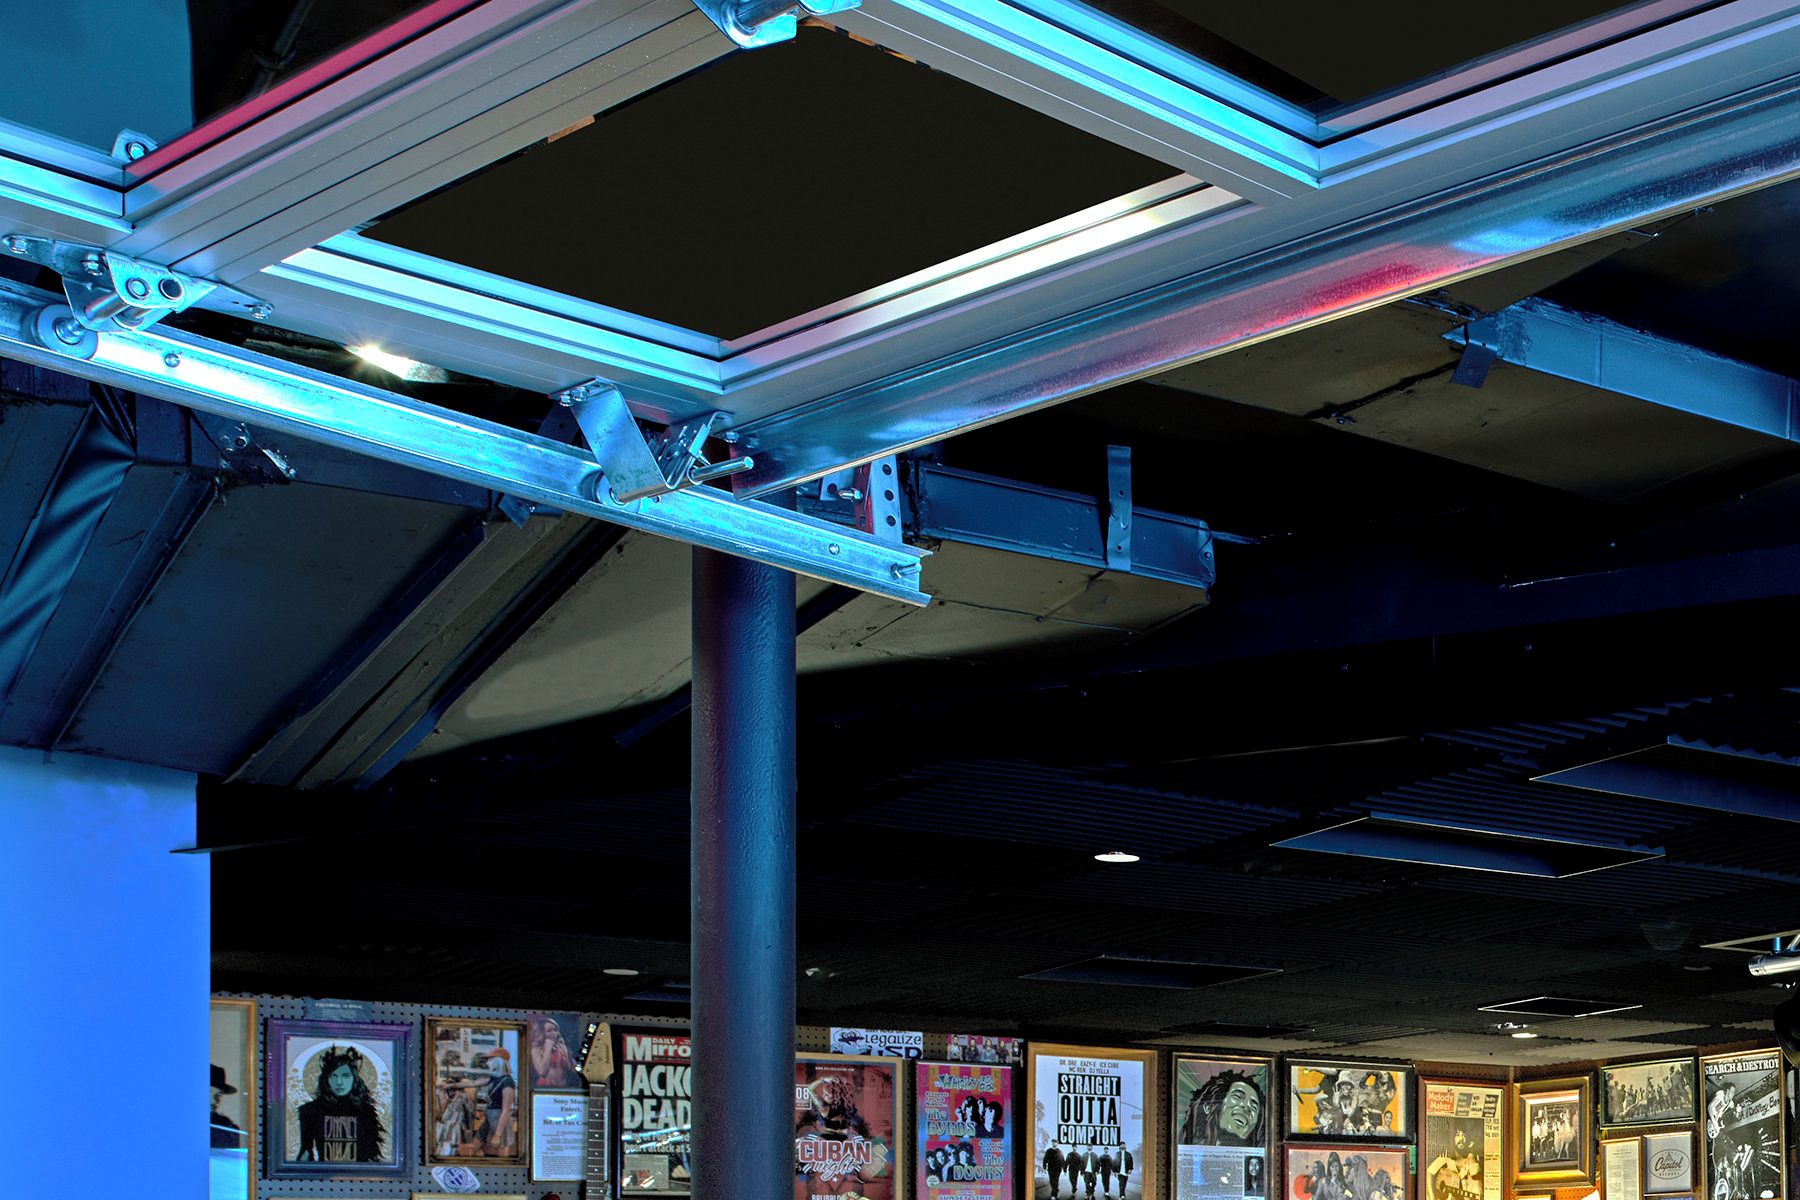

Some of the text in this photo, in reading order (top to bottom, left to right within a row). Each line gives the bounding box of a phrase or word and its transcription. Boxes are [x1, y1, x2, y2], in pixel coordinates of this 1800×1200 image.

[626, 1036, 691, 1061] Mirro
[865, 1033, 922, 1047] Legalize
[1705, 1059, 1779, 1075] SEARCH & DESTROY
[622, 1064, 691, 1097] JACK
[1060, 1074, 1118, 1095] STRAIGHT
[1428, 1092, 1454, 1102] Melody
[1430, 1101, 1451, 1109] Maker
[623, 1100, 691, 1130] DEAD
[1060, 1095, 1118, 1125] OUTTA
[1060, 1125, 1118, 1145] COMPTON
[799, 1140, 872, 1164] CUBAN
[984, 1154, 1004, 1166] The
[812, 1153, 856, 1182] night
[953, 1165, 1004, 1180] DOORS
[1655, 1157, 1683, 1172] Capitol
